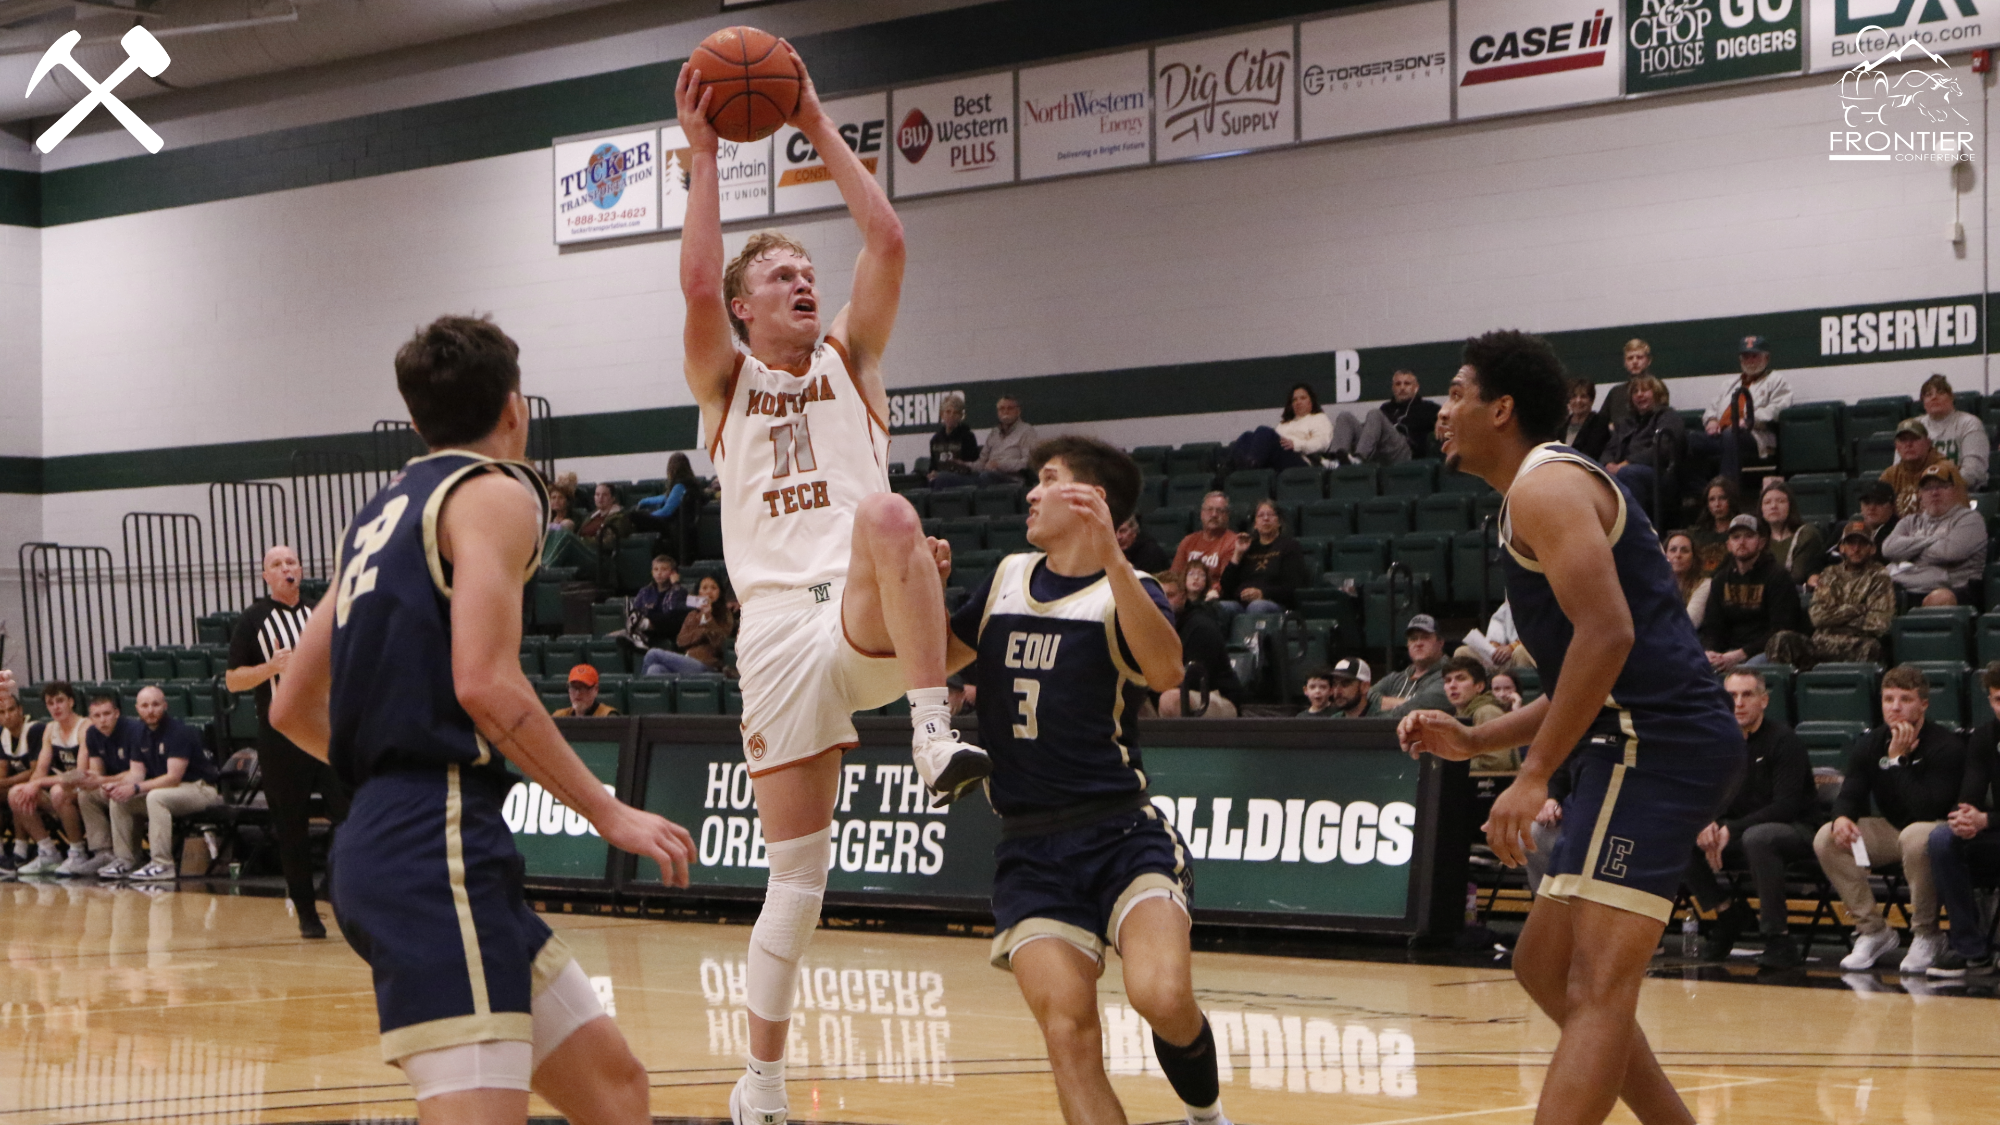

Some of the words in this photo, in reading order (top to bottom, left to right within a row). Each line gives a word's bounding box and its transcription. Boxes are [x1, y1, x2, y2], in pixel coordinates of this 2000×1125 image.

[1469, 23, 1574, 64] CASE
[1630, 8, 1712, 49] CHOP
[1716, 29, 1797, 61] DIGGERS
[1831, 24, 1982, 57] ButteAuto.com
[1327, 52, 1446, 81] TORGERSON'S
[1640, 41, 1705, 73] HOUSE
[954, 94, 992, 117] Best
[1025, 89, 1145, 126] NorthWestern
[1160, 62, 1217, 133] Dig
[1225, 48, 1290, 105] City
[786, 119, 885, 164] CSE
[901, 126, 930, 149] BW
[937, 117, 1008, 143] Western
[1100, 115, 1144, 136] Energy
[717, 141, 739, 161] cky
[951, 141, 996, 167] PLUS
[561, 142, 651, 197] TUCKER
[718, 159, 767, 181] untain
[560, 166, 653, 213] TRANSPORTATION
[735, 187, 767, 200] UNION
[567, 207, 646, 227] 1-888-323-4623
[571, 220, 641, 234] tuckertransportation.com
[1821, 304, 1977, 356] RESERVED
[1335, 350, 1361, 403] B
[769, 413, 817, 479] 11
[763, 480, 831, 517] TECH
[1004, 631, 1062, 670] EOU
[1012, 677, 1040, 740] 3
[1601, 835, 1635, 879] E
